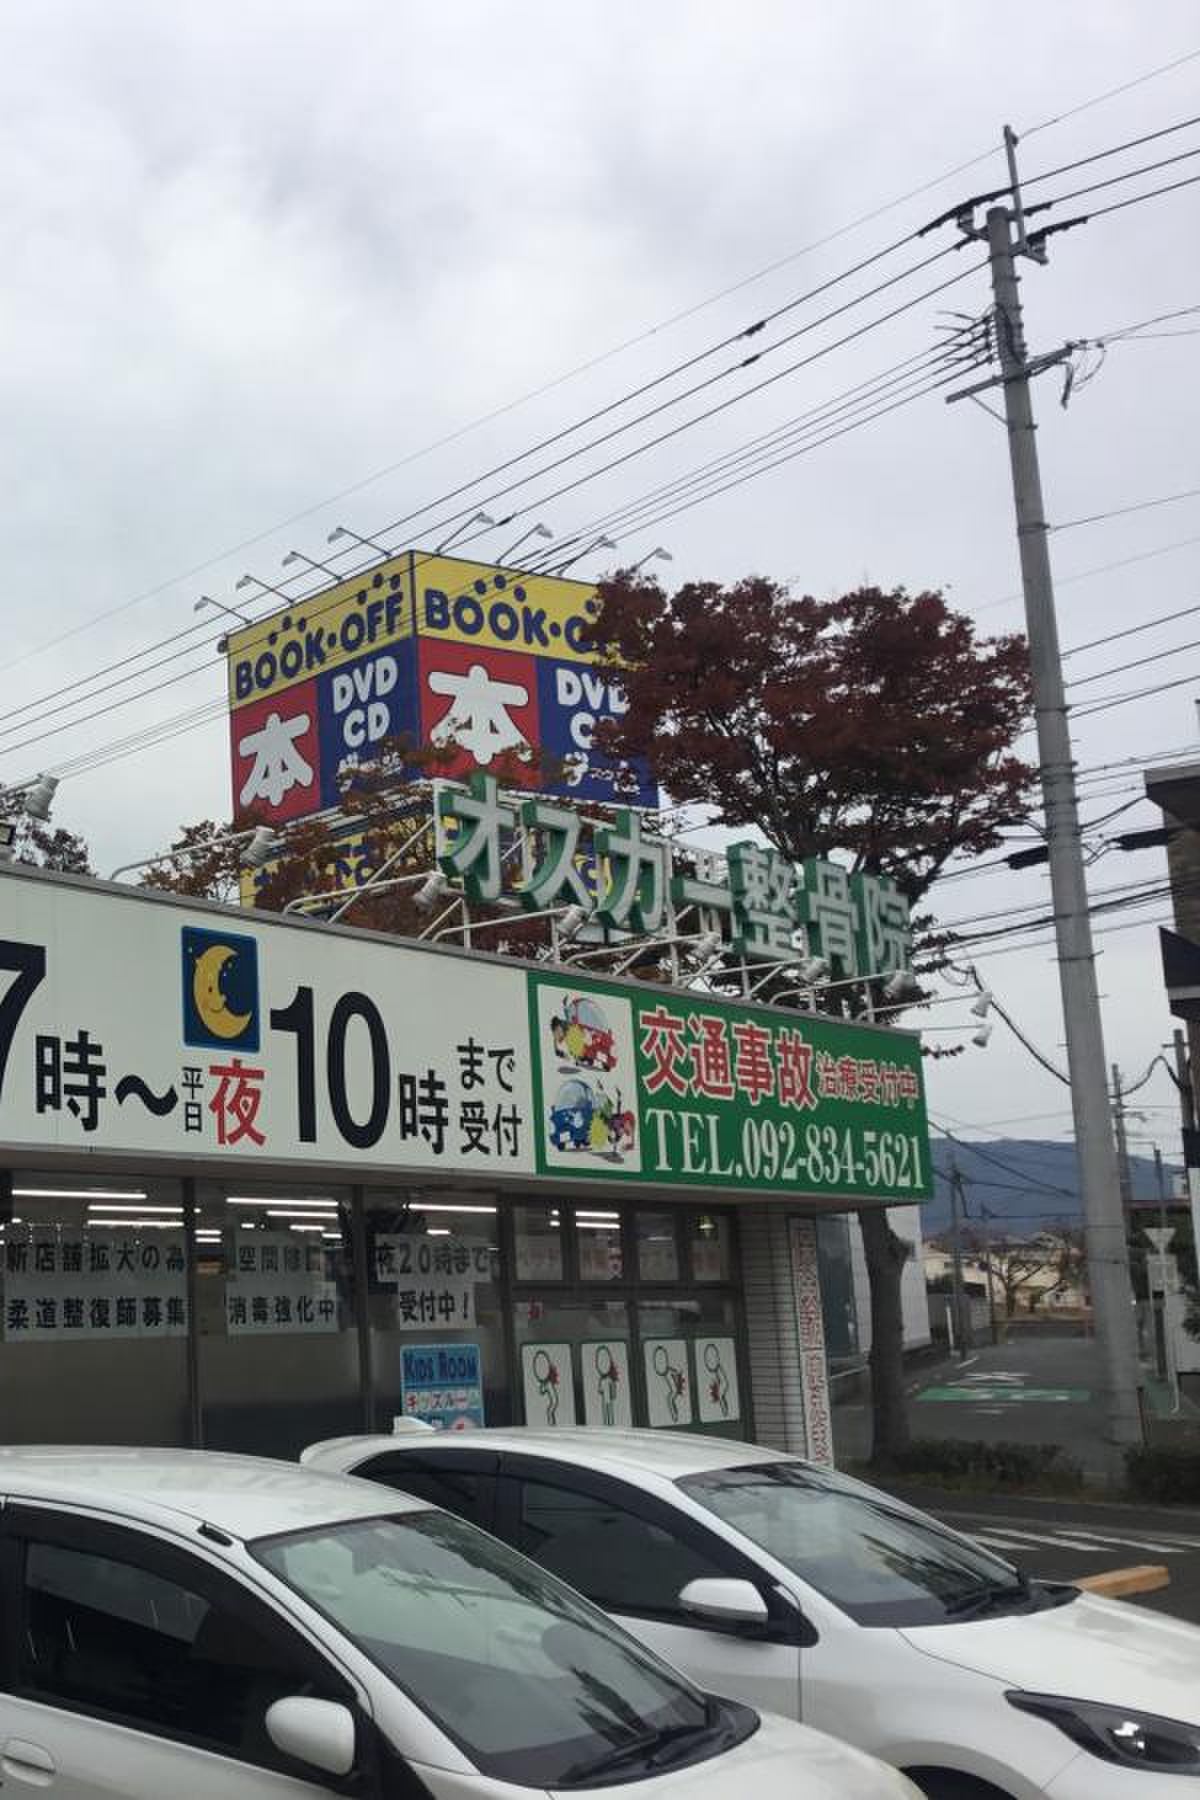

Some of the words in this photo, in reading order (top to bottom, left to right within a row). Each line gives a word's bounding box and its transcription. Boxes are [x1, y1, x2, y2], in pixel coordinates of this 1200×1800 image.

[332, 655, 398, 714] DVD
[428, 664, 532, 766] 本
[343, 702, 391, 748] CD
[239, 712, 315, 806] 本
[436, 772, 913, 978] オスカー整骨院
[181, 1066, 206, 1134] 平日
[7, 1296, 186, 1329] 柔道整復師募集
[229, 1296, 334, 1325] 消毒強化中
